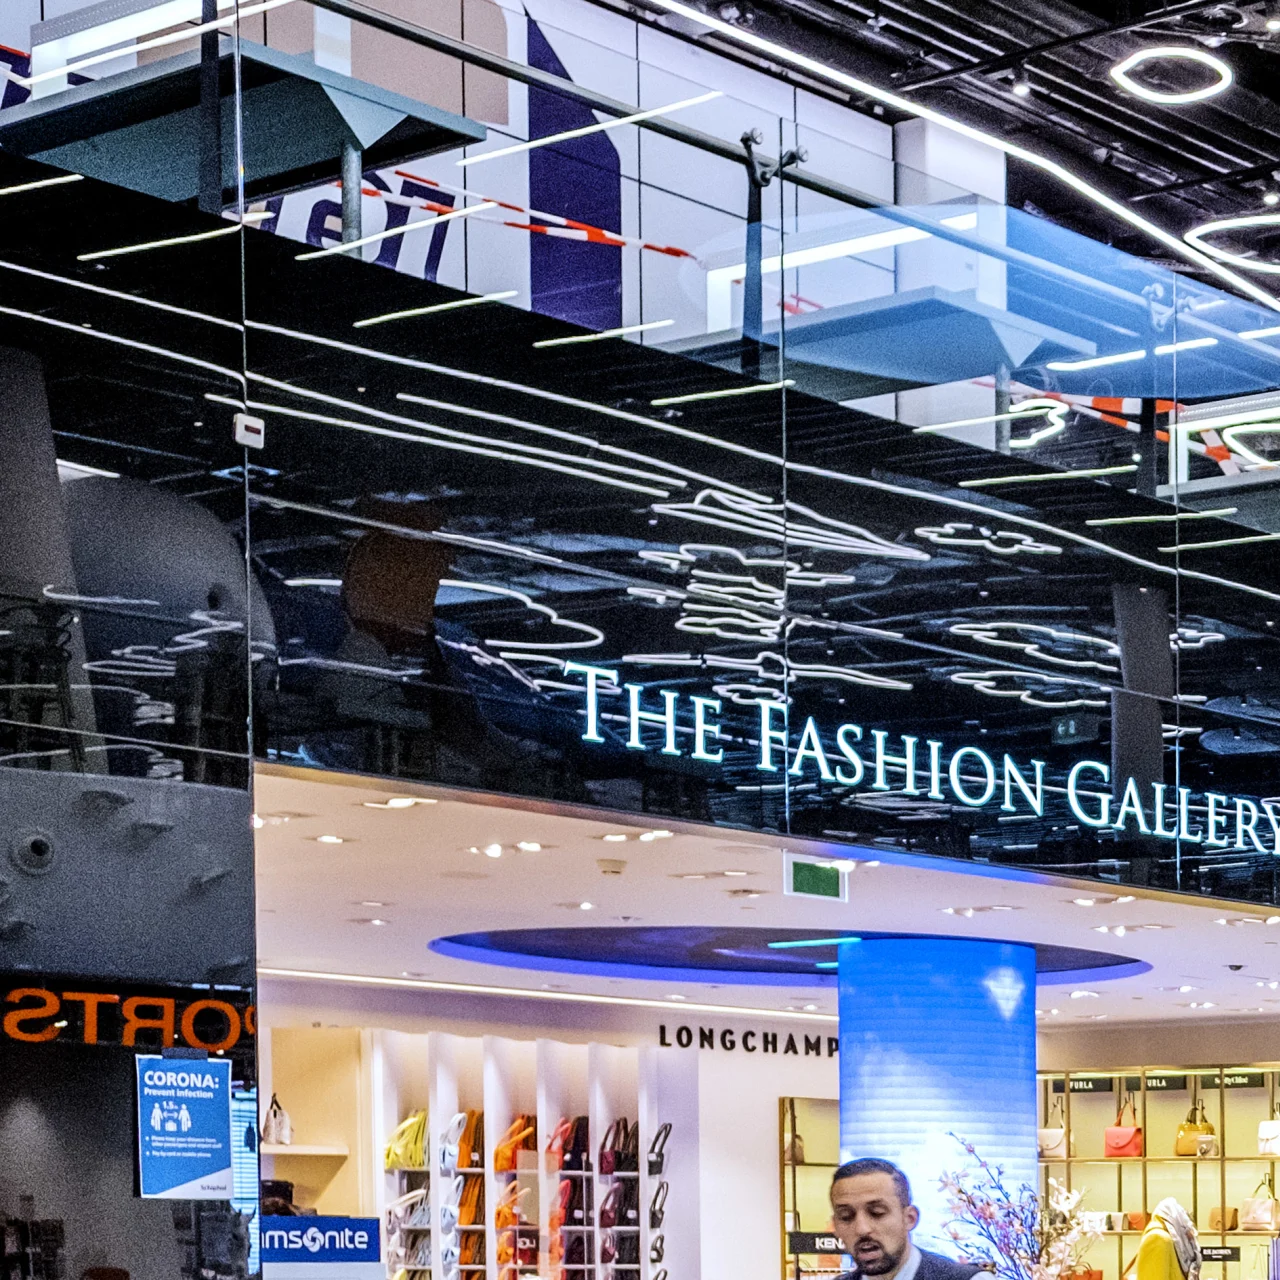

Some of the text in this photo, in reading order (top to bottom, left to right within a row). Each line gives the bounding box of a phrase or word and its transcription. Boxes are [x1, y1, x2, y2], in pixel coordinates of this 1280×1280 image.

[563, 660, 723, 763] THE
[755, 698, 1045, 816] FASHION
[659, 1025, 839, 1058] LONGCHAMP
[144, 1070, 219, 1089] CORONA:
[1147, 1079, 1167, 1088] URLA
[144, 1087, 214, 1099] Prevent infection
[815, 1237, 846, 1250] KEN
